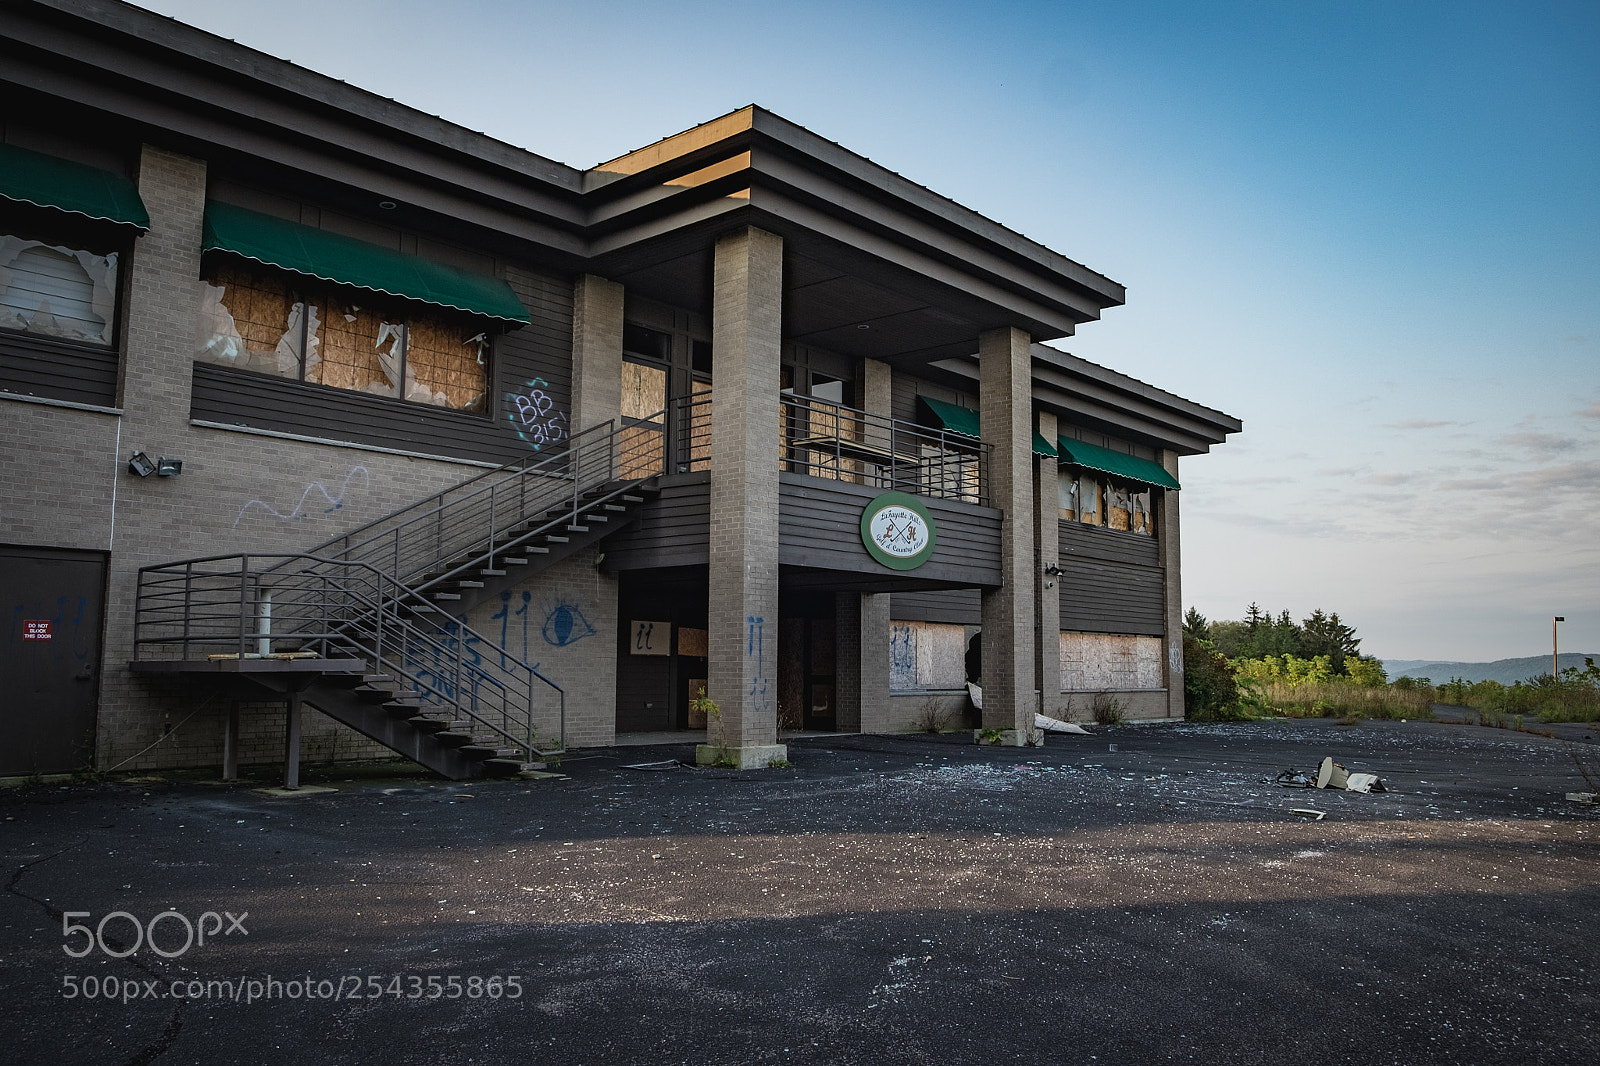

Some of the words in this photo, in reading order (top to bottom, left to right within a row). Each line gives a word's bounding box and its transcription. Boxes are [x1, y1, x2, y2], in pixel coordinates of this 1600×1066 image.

[883, 524, 894, 539] L
[906, 525, 917, 541] H
[876, 534, 886, 546] Golf
[893, 545, 912, 553] Country
